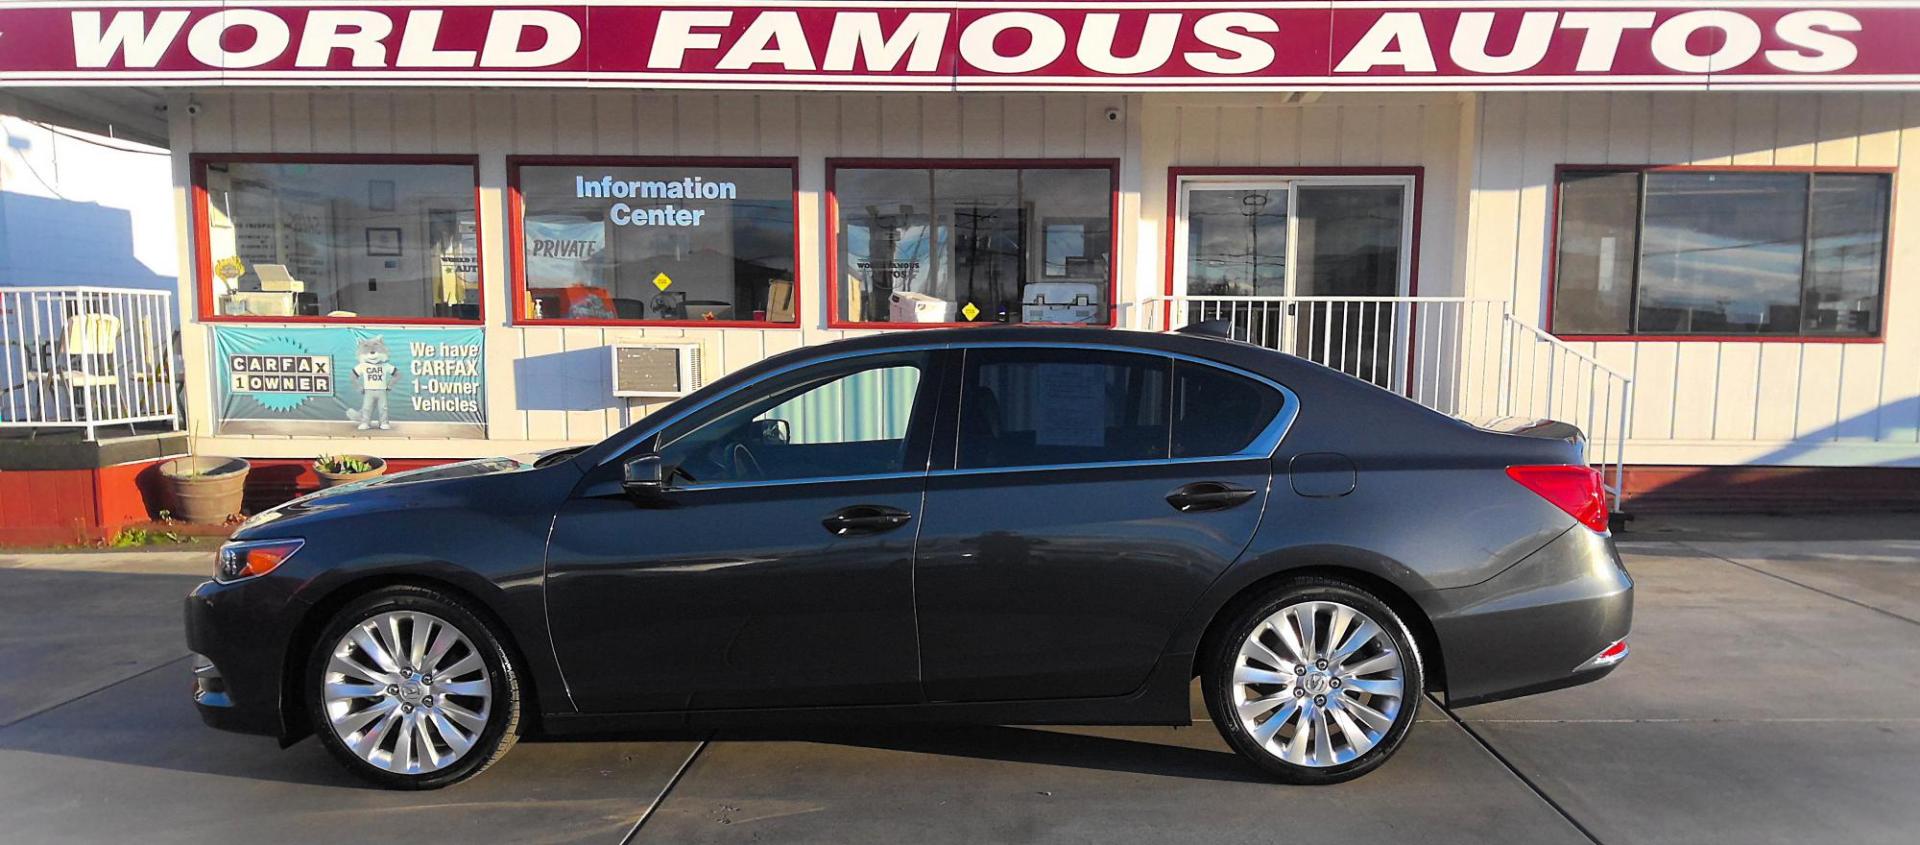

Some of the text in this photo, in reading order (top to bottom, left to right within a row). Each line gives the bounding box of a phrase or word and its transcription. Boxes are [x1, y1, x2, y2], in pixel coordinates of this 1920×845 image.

[71, 9, 1863, 75] WORLD FAMOUS AUTOS
[576, 175, 737, 200] Information
[610, 202, 705, 227] Center
[532, 239, 597, 259] PRIVATE
[409, 341, 480, 357] We have
[233, 357, 326, 374] CARFAX
[410, 359, 479, 377] CARFAX
[236, 377, 327, 391] 1 OWNER
[411, 378, 480, 394] 1-Owner
[411, 395, 478, 412] Vehicles
